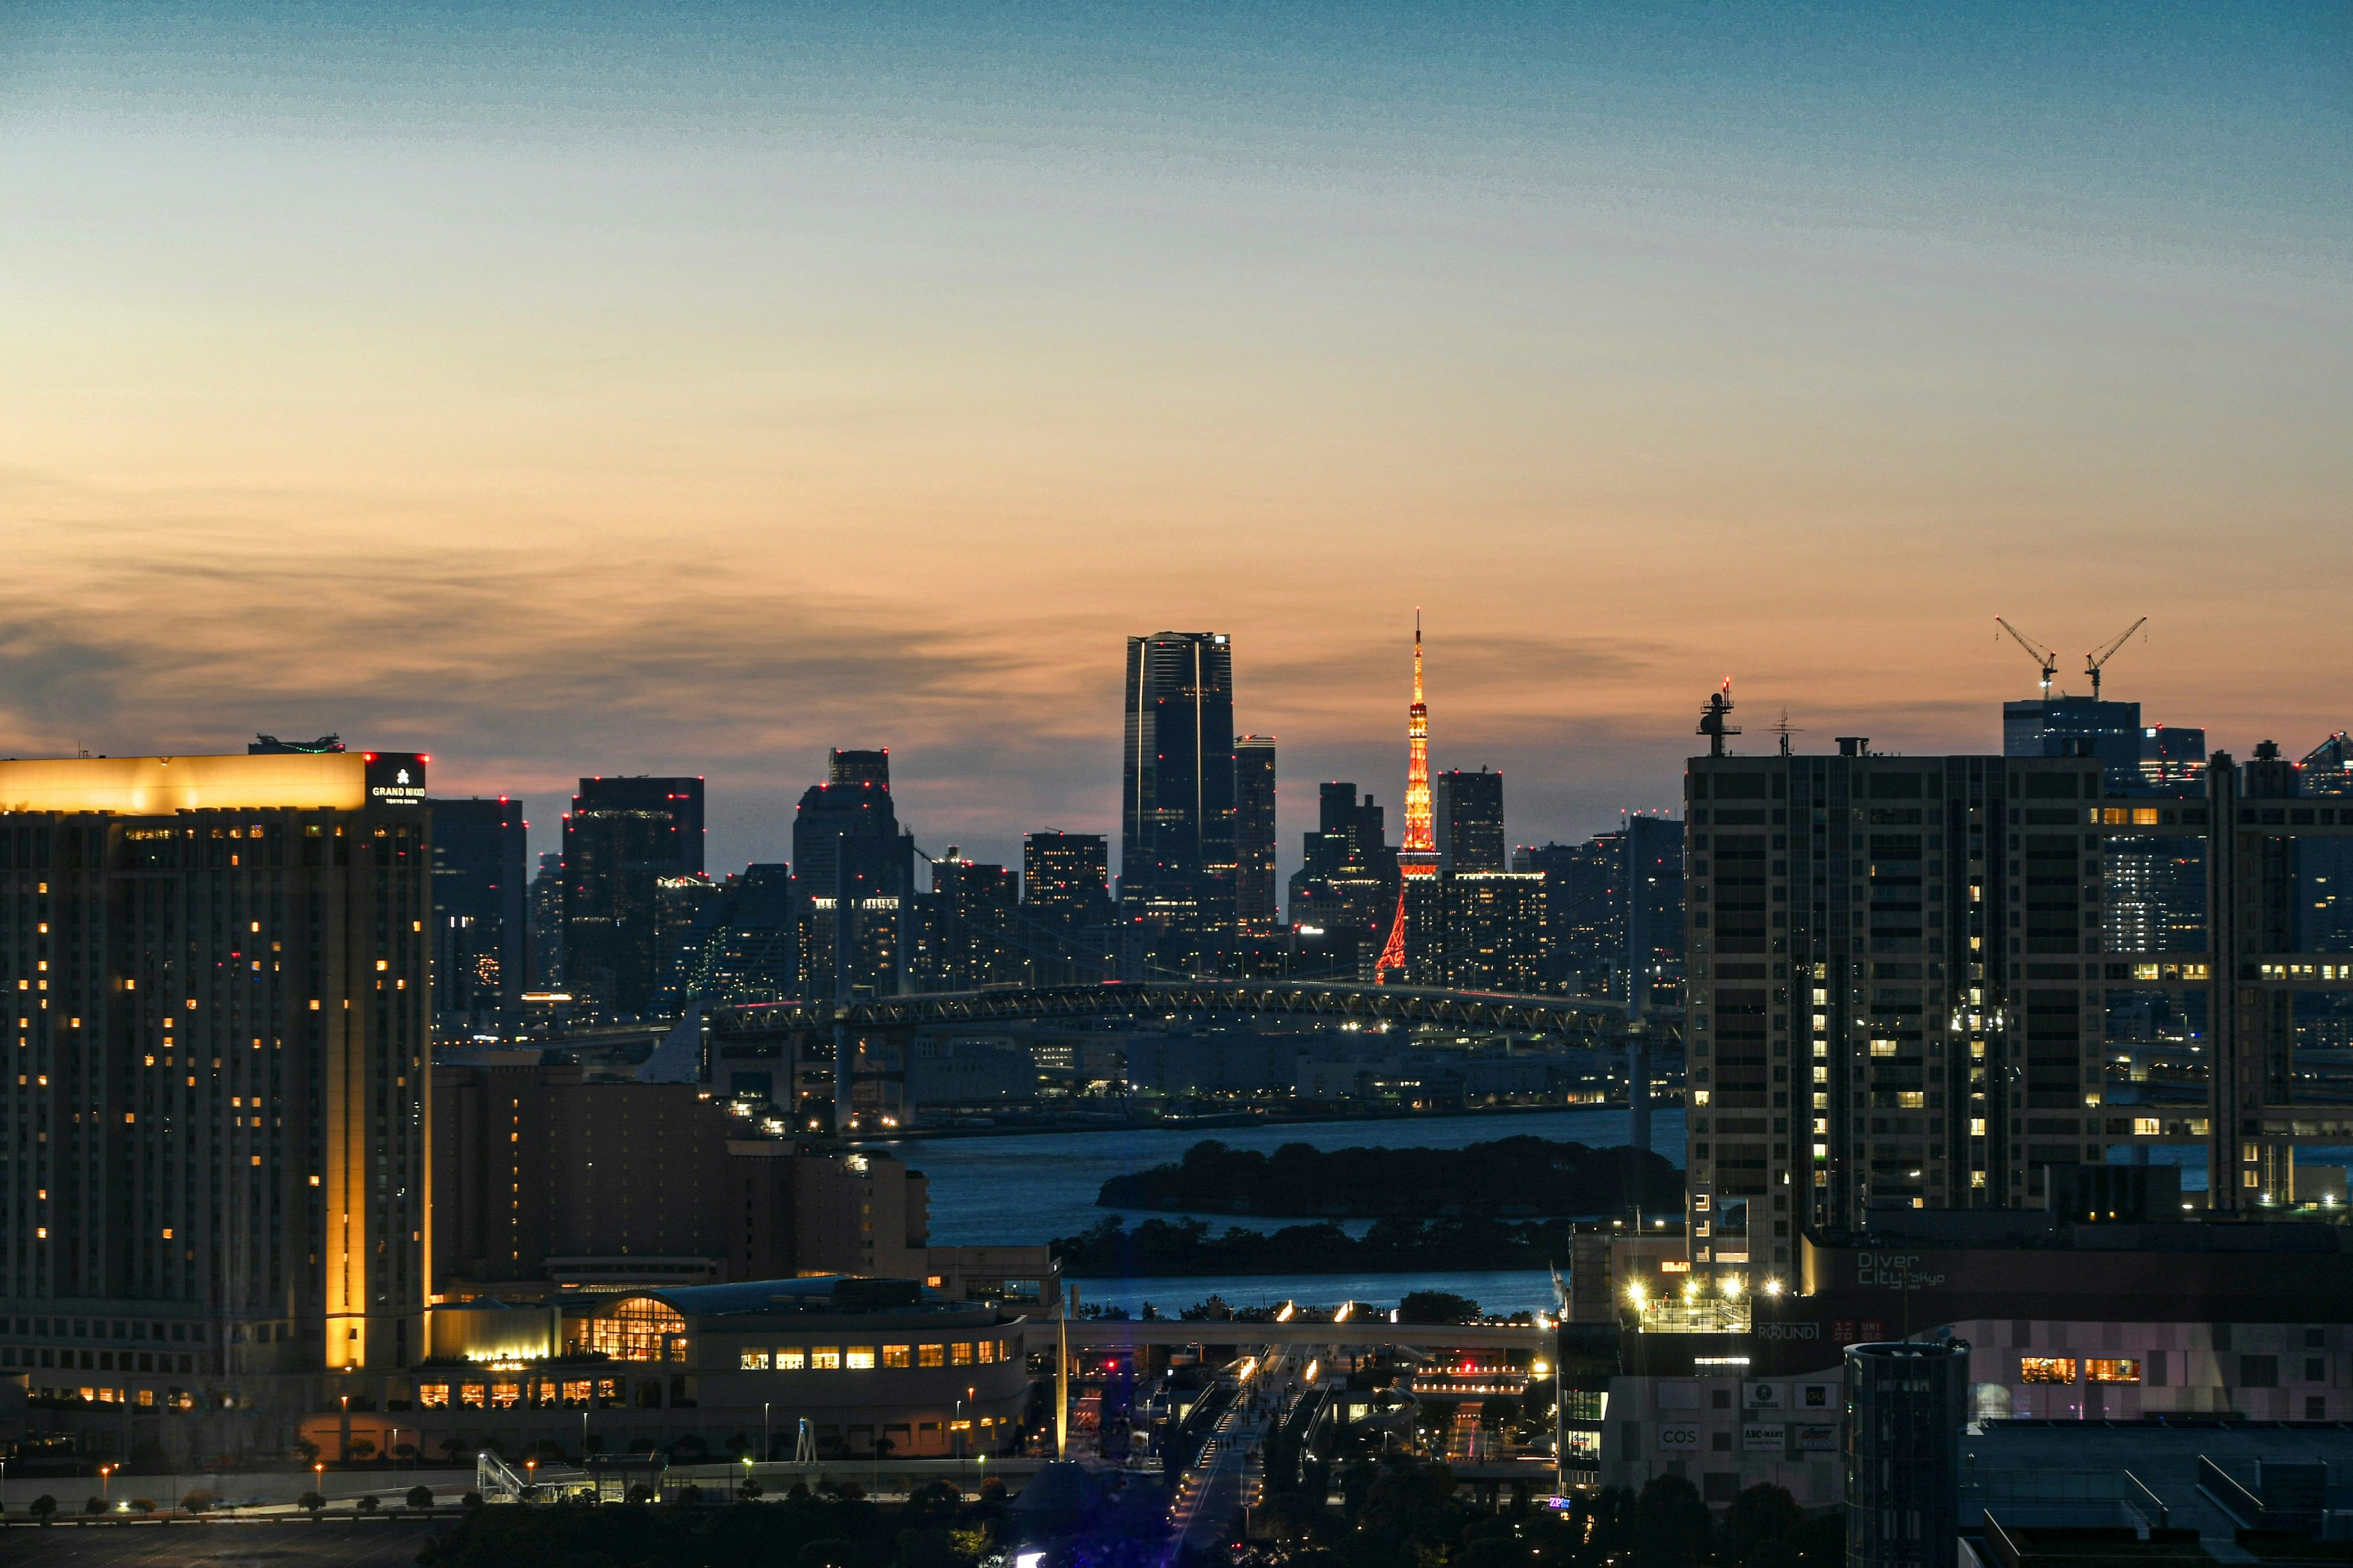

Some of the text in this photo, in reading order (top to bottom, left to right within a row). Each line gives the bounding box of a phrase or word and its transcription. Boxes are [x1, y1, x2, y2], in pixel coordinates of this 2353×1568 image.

[373, 787, 425, 797] GRAND NIKKO
[1858, 1252, 1919, 1268] Diver
[1858, 1268, 1903, 1289] City
[1862, 1322, 1880, 1331] UNI
[1807, 1392, 1824, 1401] GU
[1662, 1431, 1696, 1443] COS
